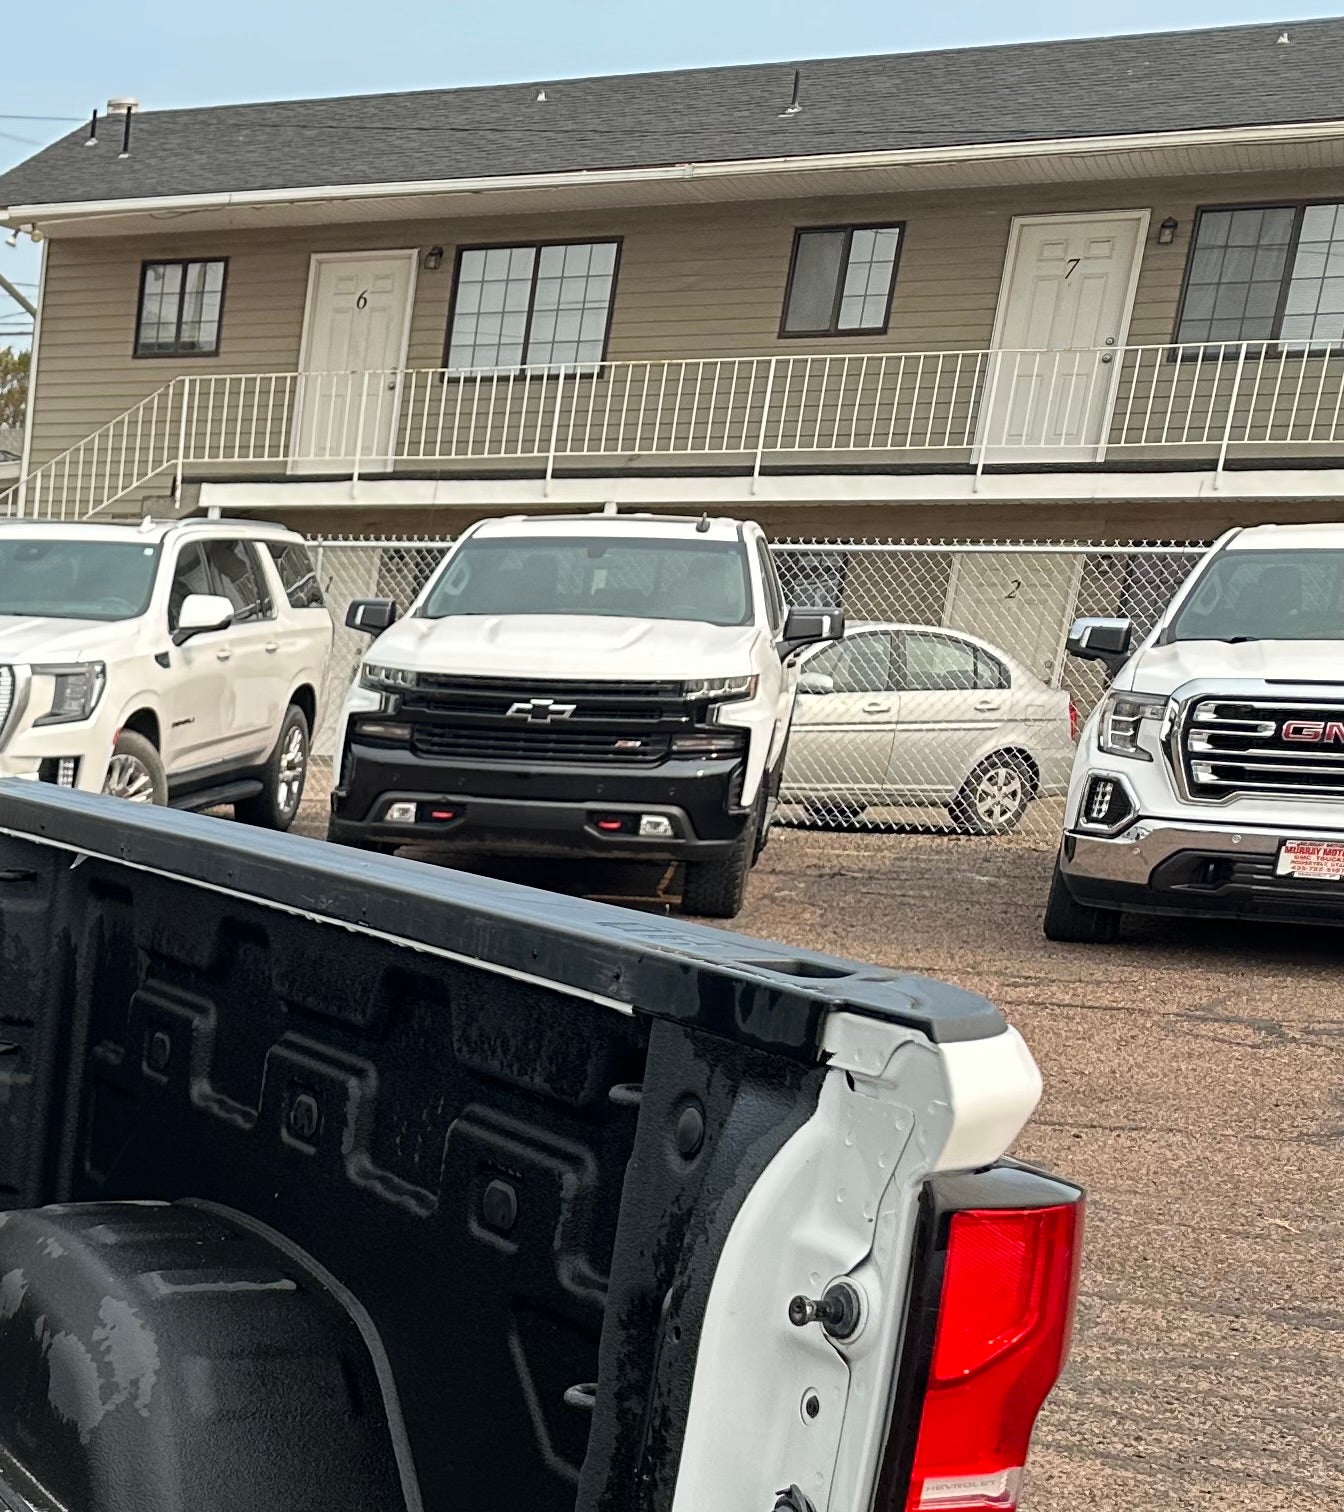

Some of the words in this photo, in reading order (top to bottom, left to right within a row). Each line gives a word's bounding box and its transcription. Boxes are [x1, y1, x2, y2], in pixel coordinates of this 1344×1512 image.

[1064, 258, 1081, 280] 7
[356, 289, 369, 310] 6
[1004, 579, 1021, 599] 2
[925, 1480, 995, 1492] HEVROLET
